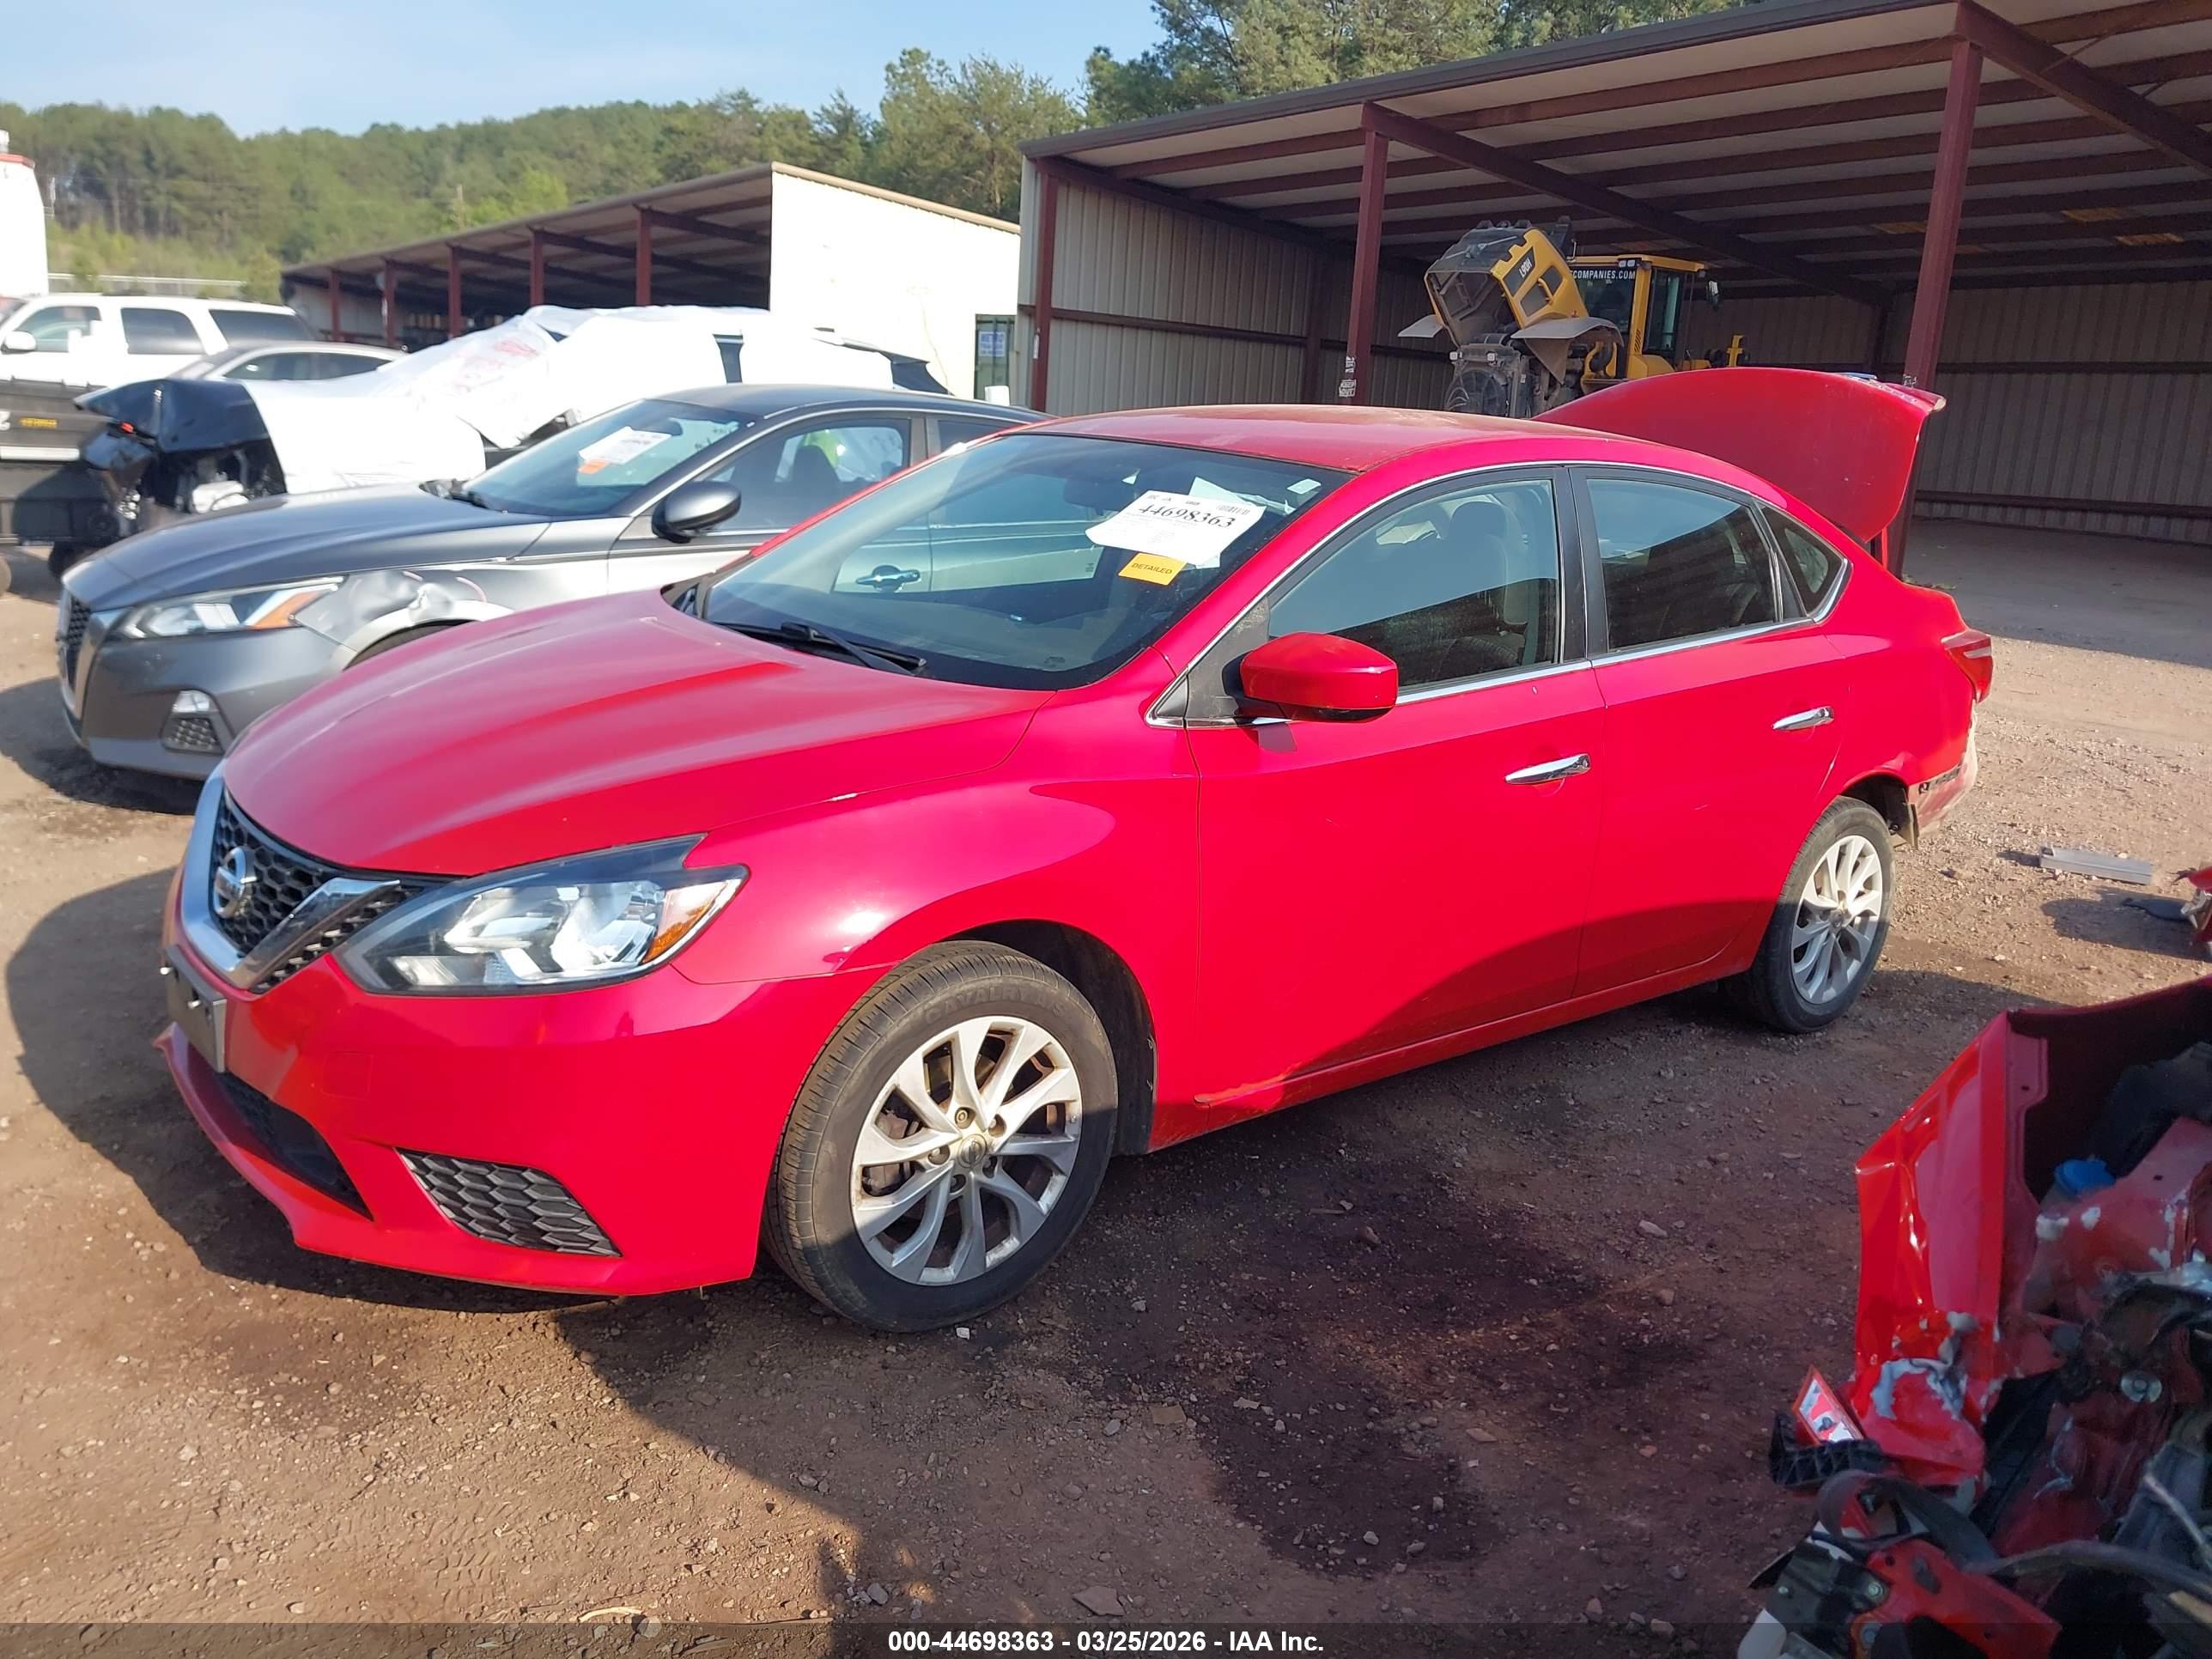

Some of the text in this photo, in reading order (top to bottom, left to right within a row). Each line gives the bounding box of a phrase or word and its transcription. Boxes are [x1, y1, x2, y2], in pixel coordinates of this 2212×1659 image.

[1570, 270, 1636, 279] COMPANIES.COM
[1139, 504, 1236, 528] 44698363
[1131, 562, 1173, 574] DETAILED
